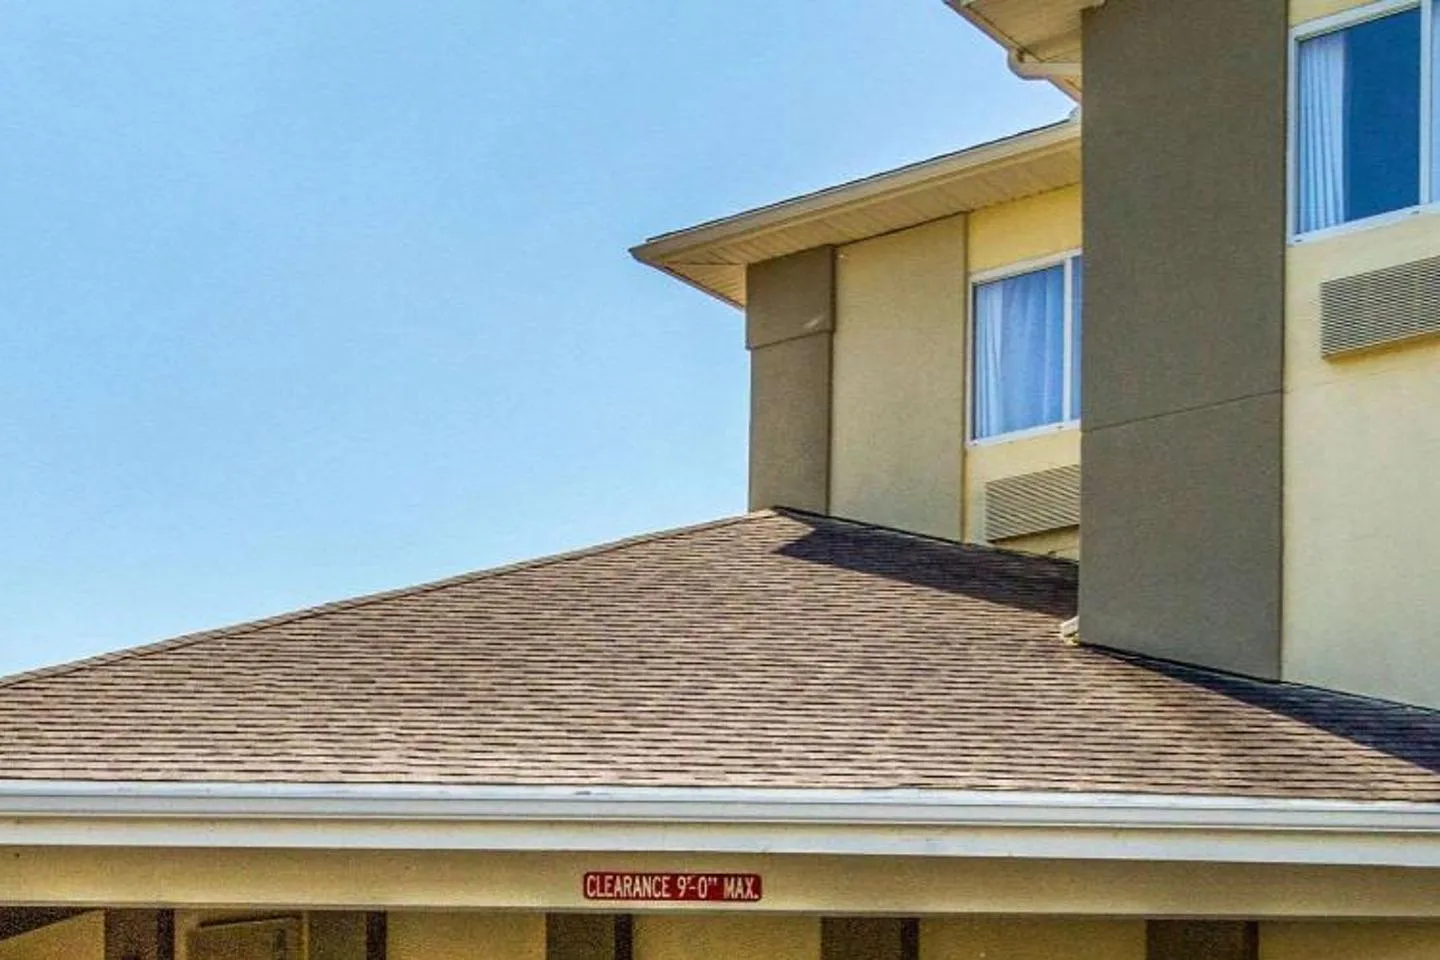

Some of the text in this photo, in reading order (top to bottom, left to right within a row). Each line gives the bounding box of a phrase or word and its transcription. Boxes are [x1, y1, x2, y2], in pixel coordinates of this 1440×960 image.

[586, 875, 759, 900] CLEARANCE 9'-0" MAX.
